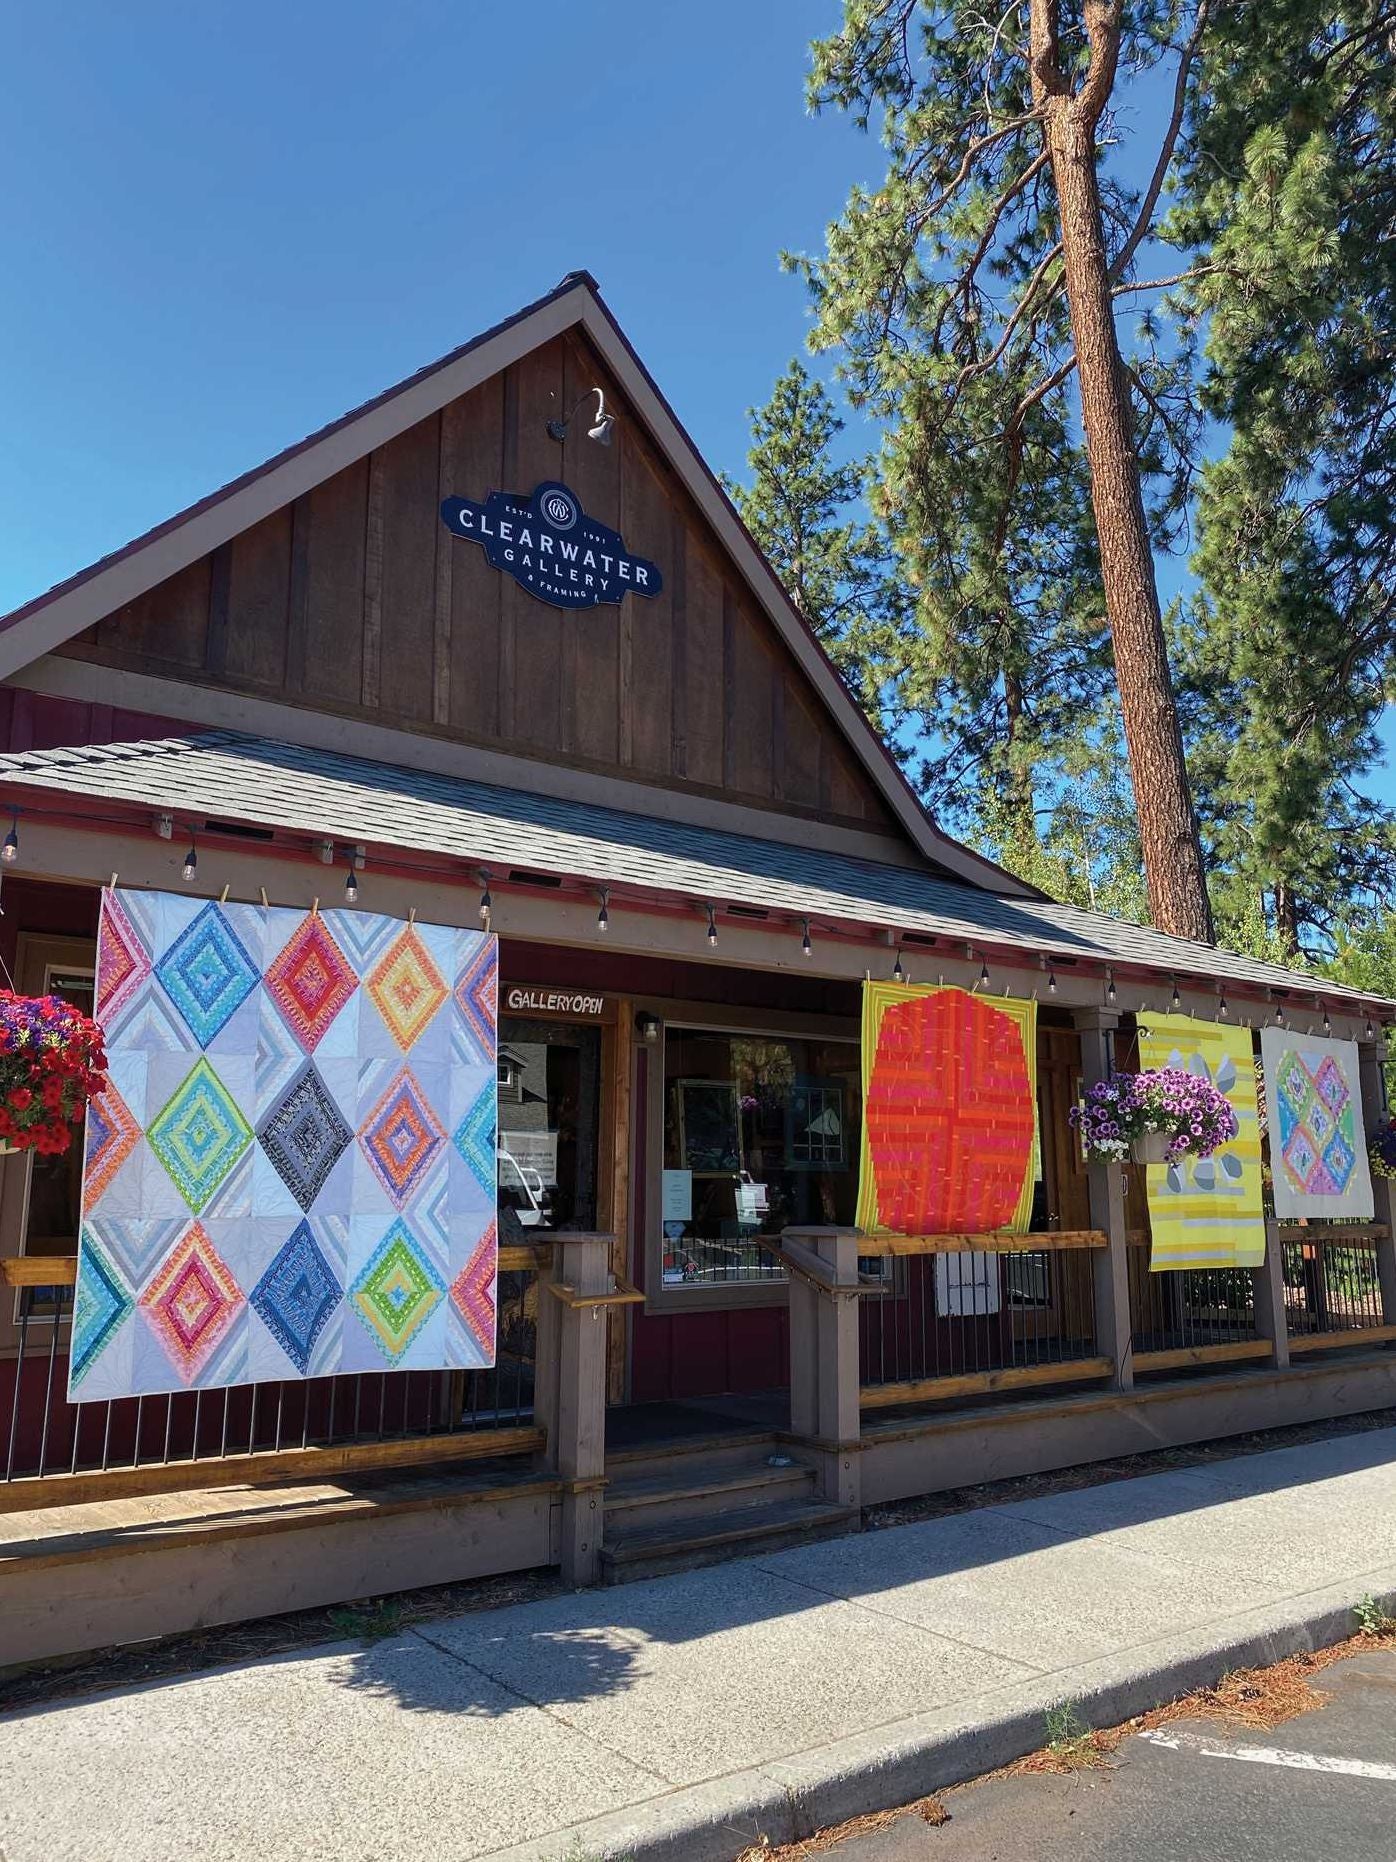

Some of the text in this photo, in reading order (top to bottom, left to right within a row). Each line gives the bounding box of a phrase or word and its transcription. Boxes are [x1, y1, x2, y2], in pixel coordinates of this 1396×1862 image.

[459, 509, 648, 586] CLEARWATER
[504, 549, 608, 591] GALLERY
[540, 581, 587, 598] FRAMING
